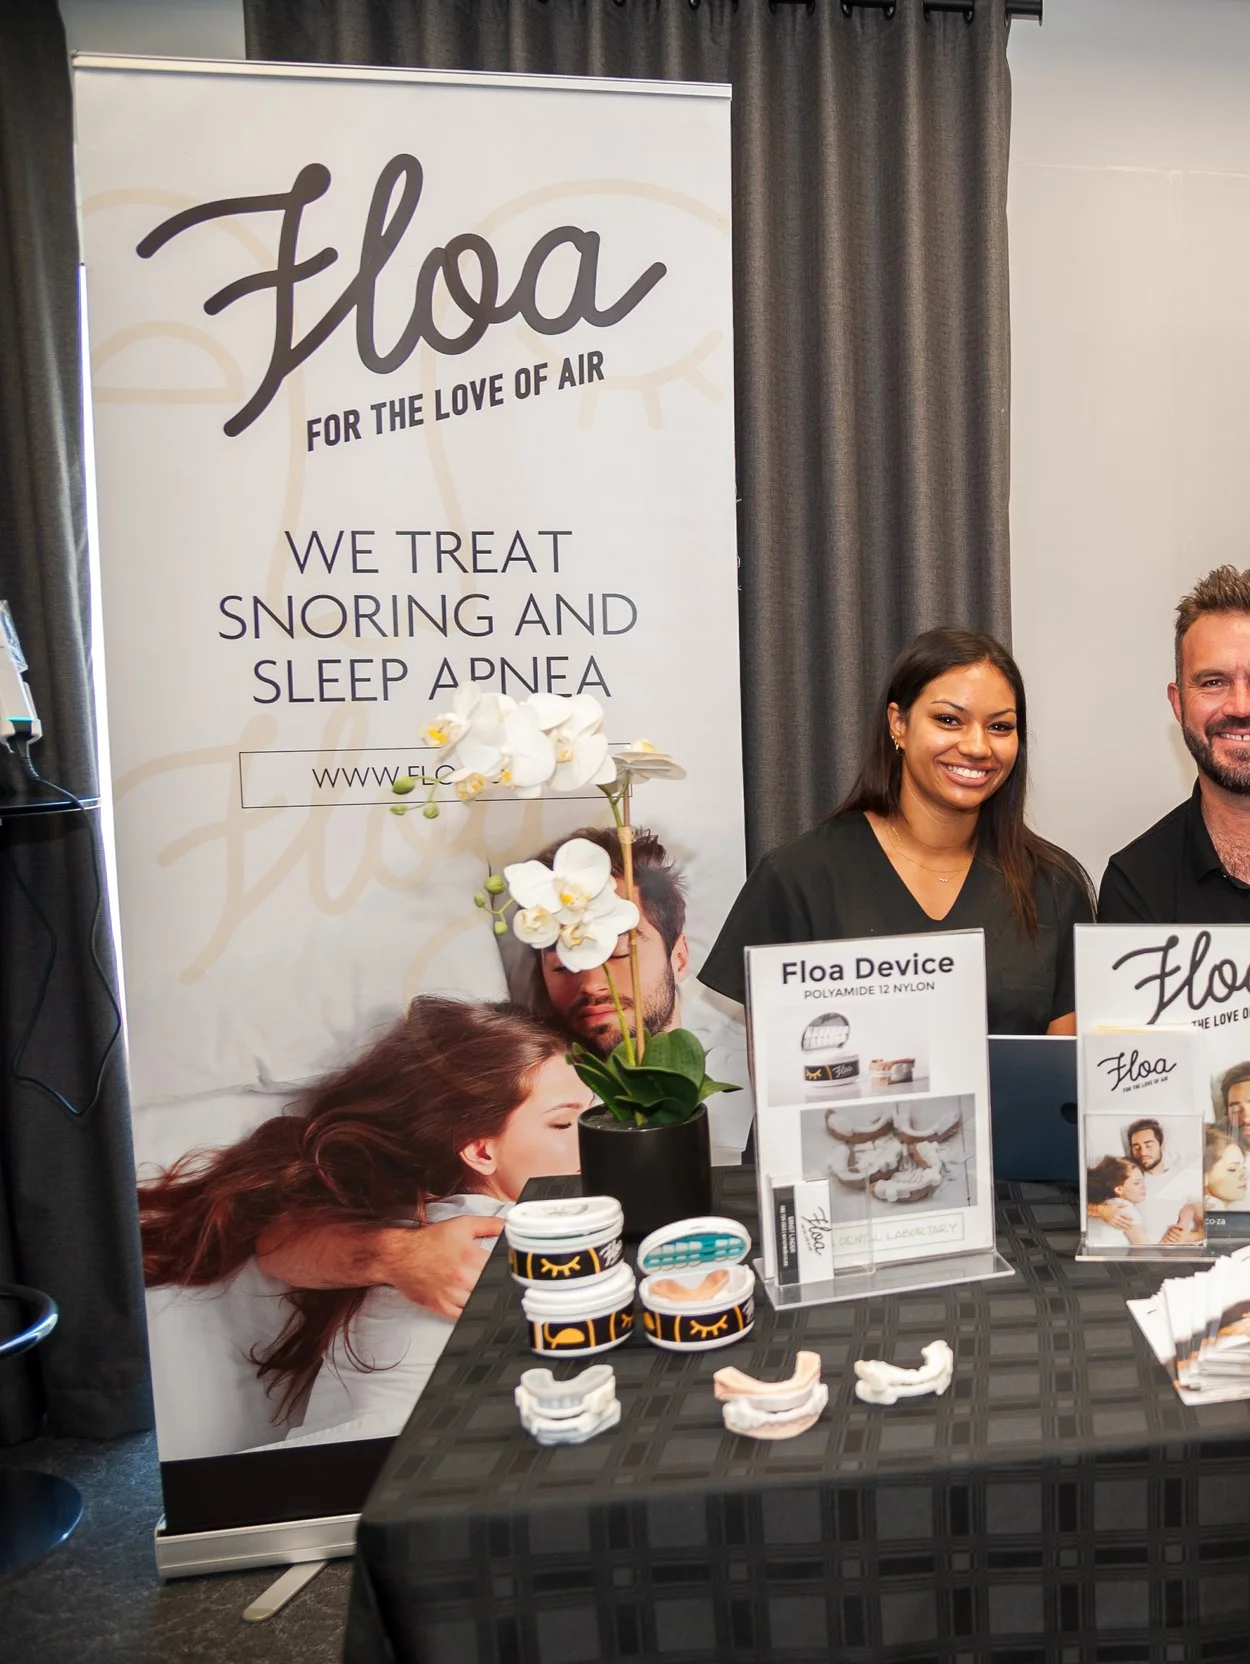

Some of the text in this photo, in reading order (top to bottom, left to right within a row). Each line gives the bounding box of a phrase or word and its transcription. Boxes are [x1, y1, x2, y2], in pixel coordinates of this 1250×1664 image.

[136, 153, 667, 437] Floa
[307, 351, 605, 451] FOR THE LOVE OF AIR
[284, 530, 572, 574] WE TREAT
[218, 593, 638, 640] SNORING AND
[253, 655, 612, 704] SLEEP APNEA
[782, 953, 955, 984] Floa Device
[804, 982, 936, 1000] POLYAMIDE 12 NYLON
[1192, 1018, 1210, 1030] THE
[1214, 1010, 1239, 1027] LOVE
[1097, 1049, 1177, 1091] Floa
[801, 1205, 832, 1256] Floa
